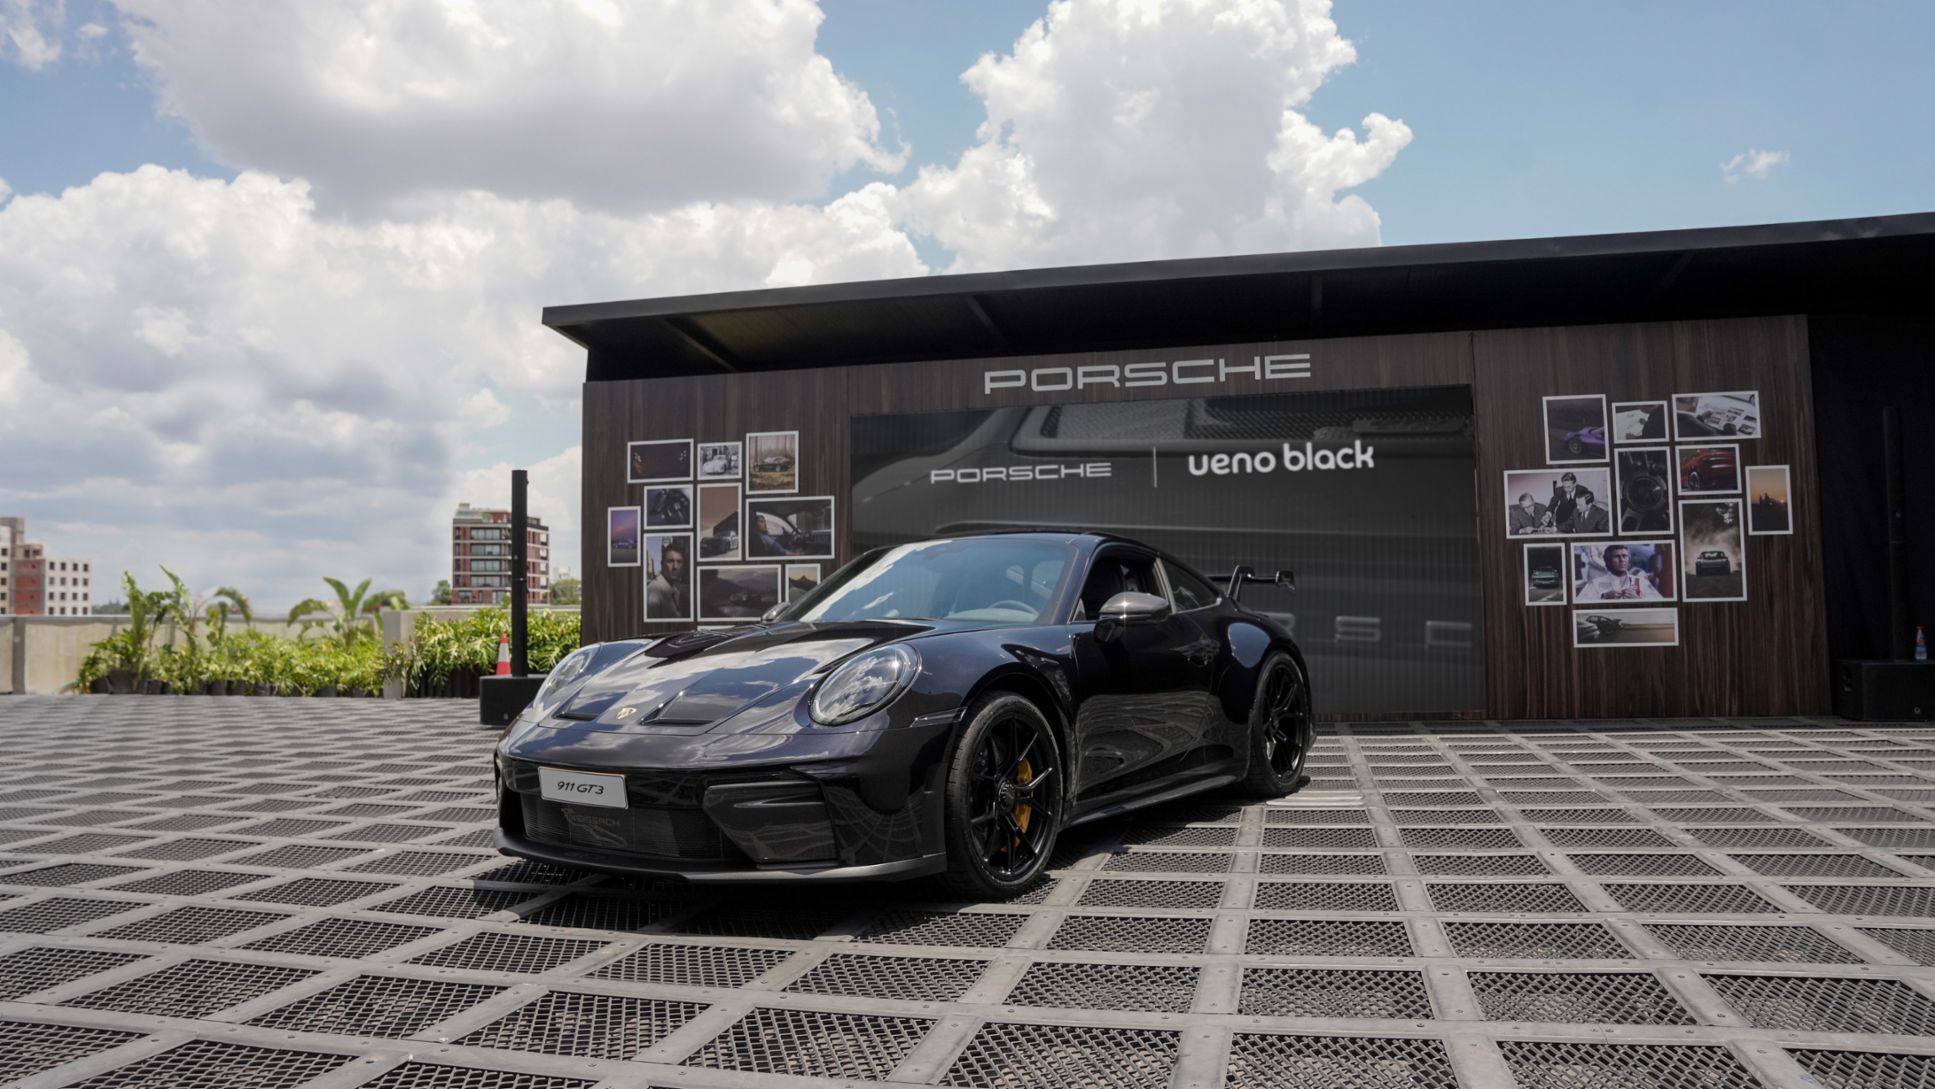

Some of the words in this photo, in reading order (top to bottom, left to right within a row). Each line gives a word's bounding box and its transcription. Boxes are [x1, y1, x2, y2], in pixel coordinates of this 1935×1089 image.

[984, 353, 1312, 395] PORSCHE
[929, 462, 1112, 485] PORSCHE
[1188, 451, 1277, 476] ueno
[1282, 439, 1376, 472] black
[557, 780, 576, 792] 911
[576, 783, 605, 795] GT3
